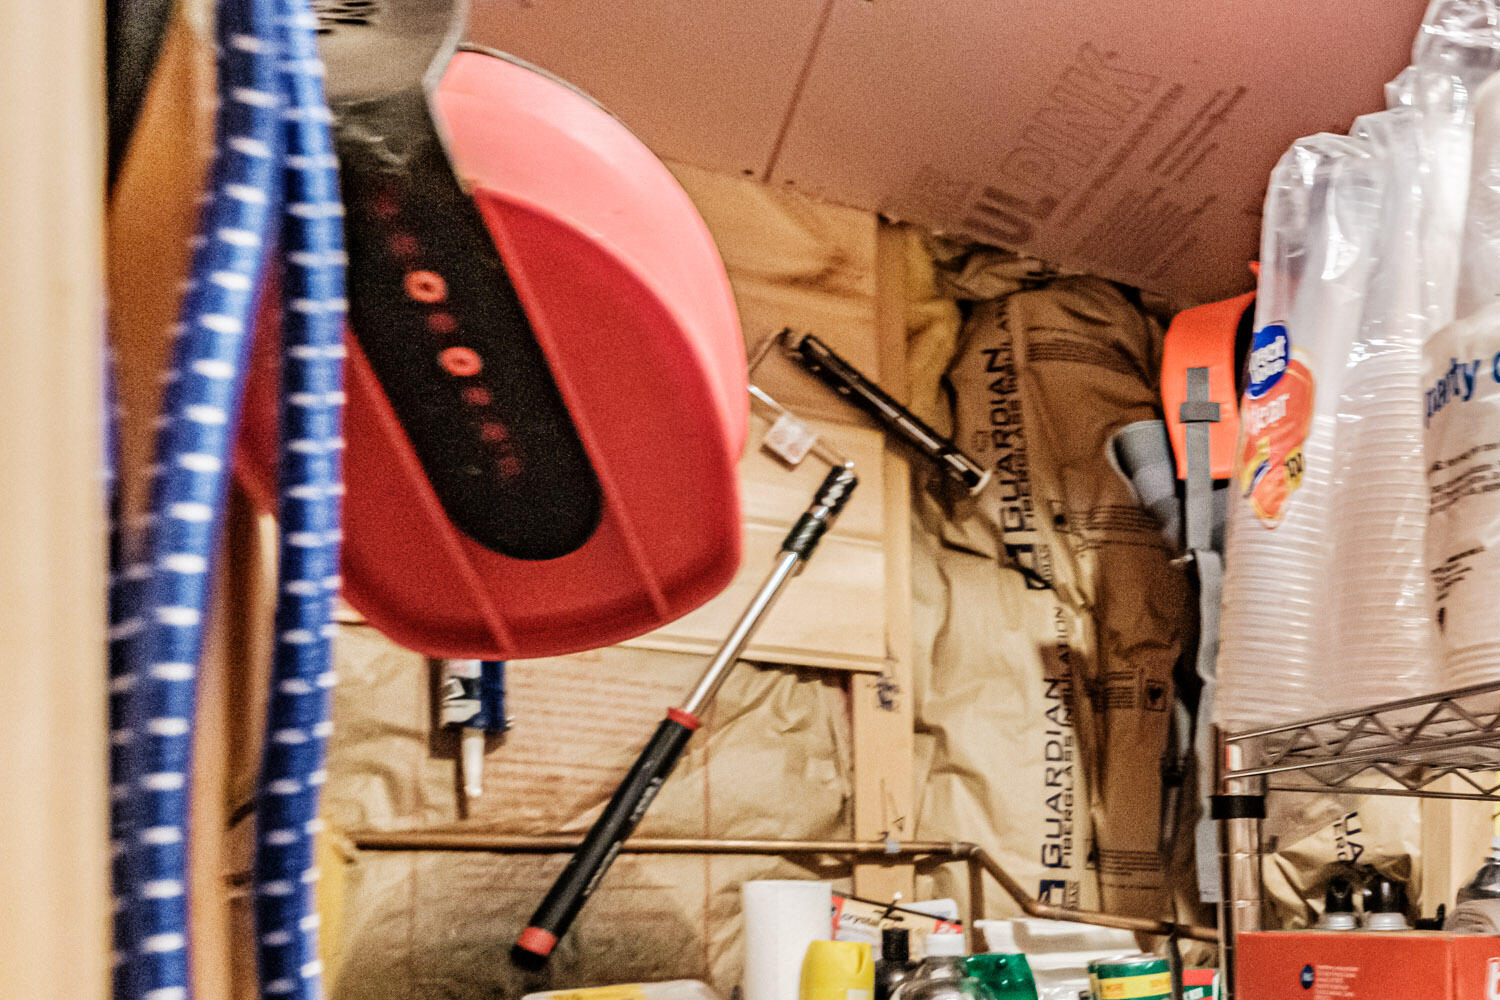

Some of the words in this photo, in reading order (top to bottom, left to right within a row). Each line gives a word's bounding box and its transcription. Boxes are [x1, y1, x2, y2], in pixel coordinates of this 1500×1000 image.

[982, 347, 1026, 533] GUARDIAN
[1041, 677, 1066, 870] GUARDIAN
[1059, 733, 1075, 870] FIBERGLASS
